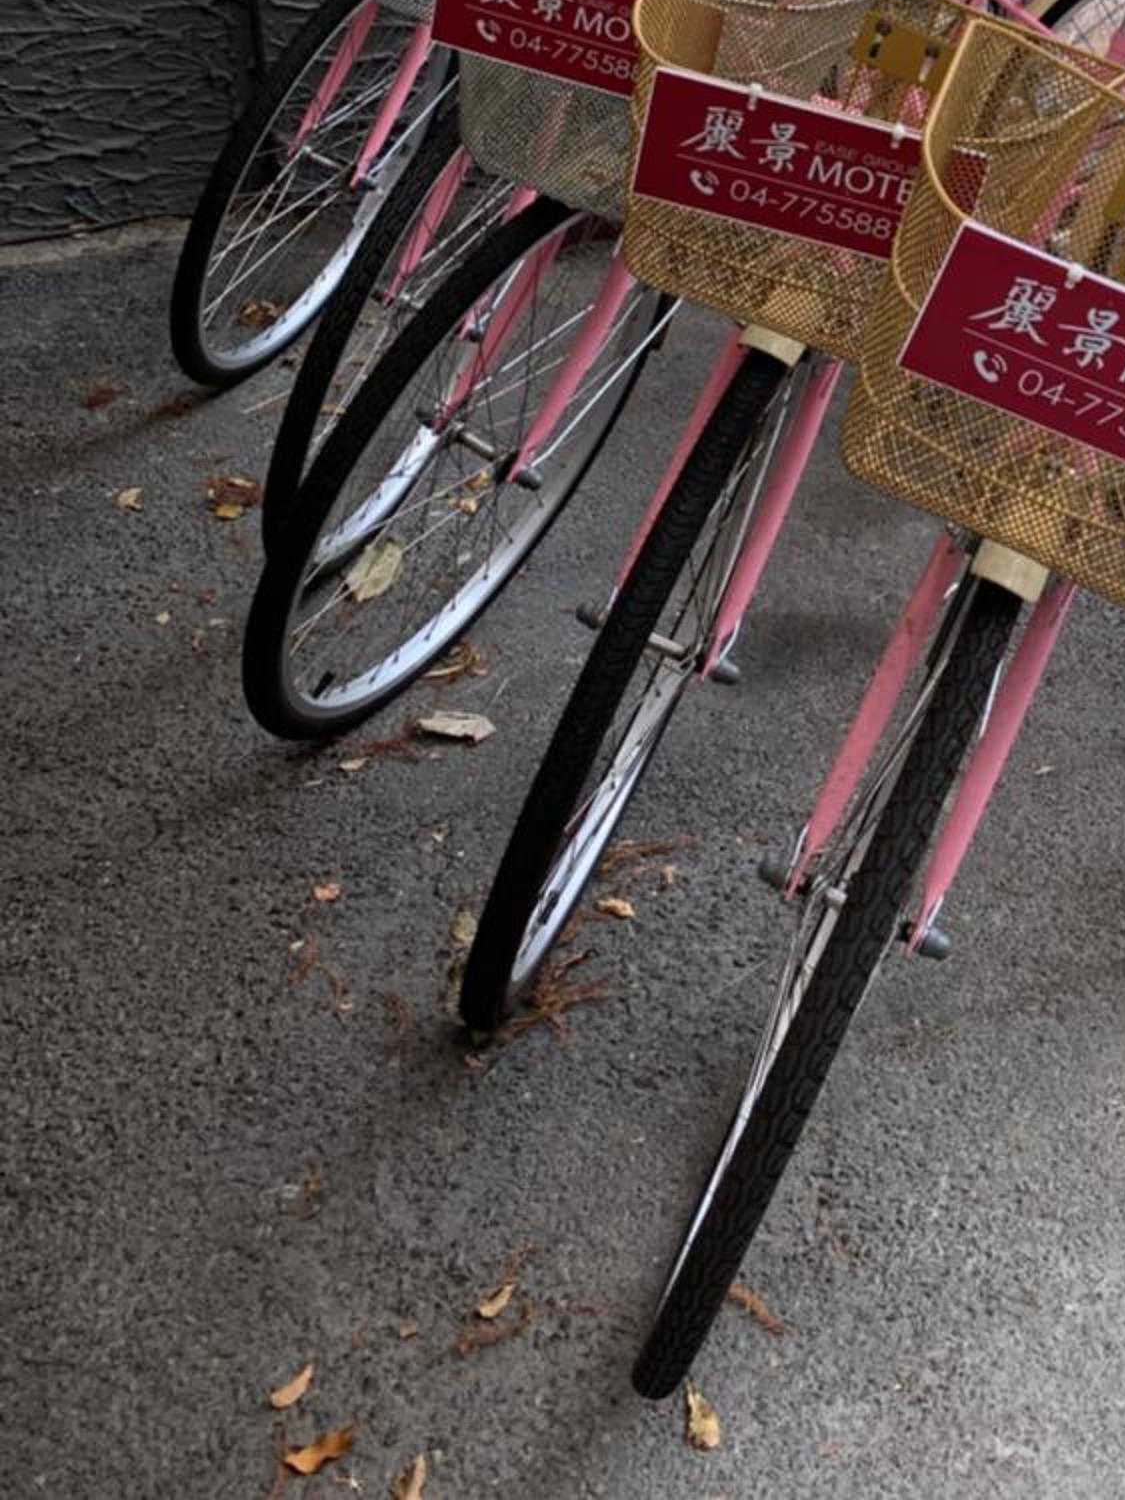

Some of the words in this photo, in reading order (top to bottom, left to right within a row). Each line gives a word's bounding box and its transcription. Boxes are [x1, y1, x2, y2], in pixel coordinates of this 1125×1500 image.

[573, 6, 640, 47] MO
[679, 106, 809, 173] 麗景
[729, 179, 901, 240] 04-775588
